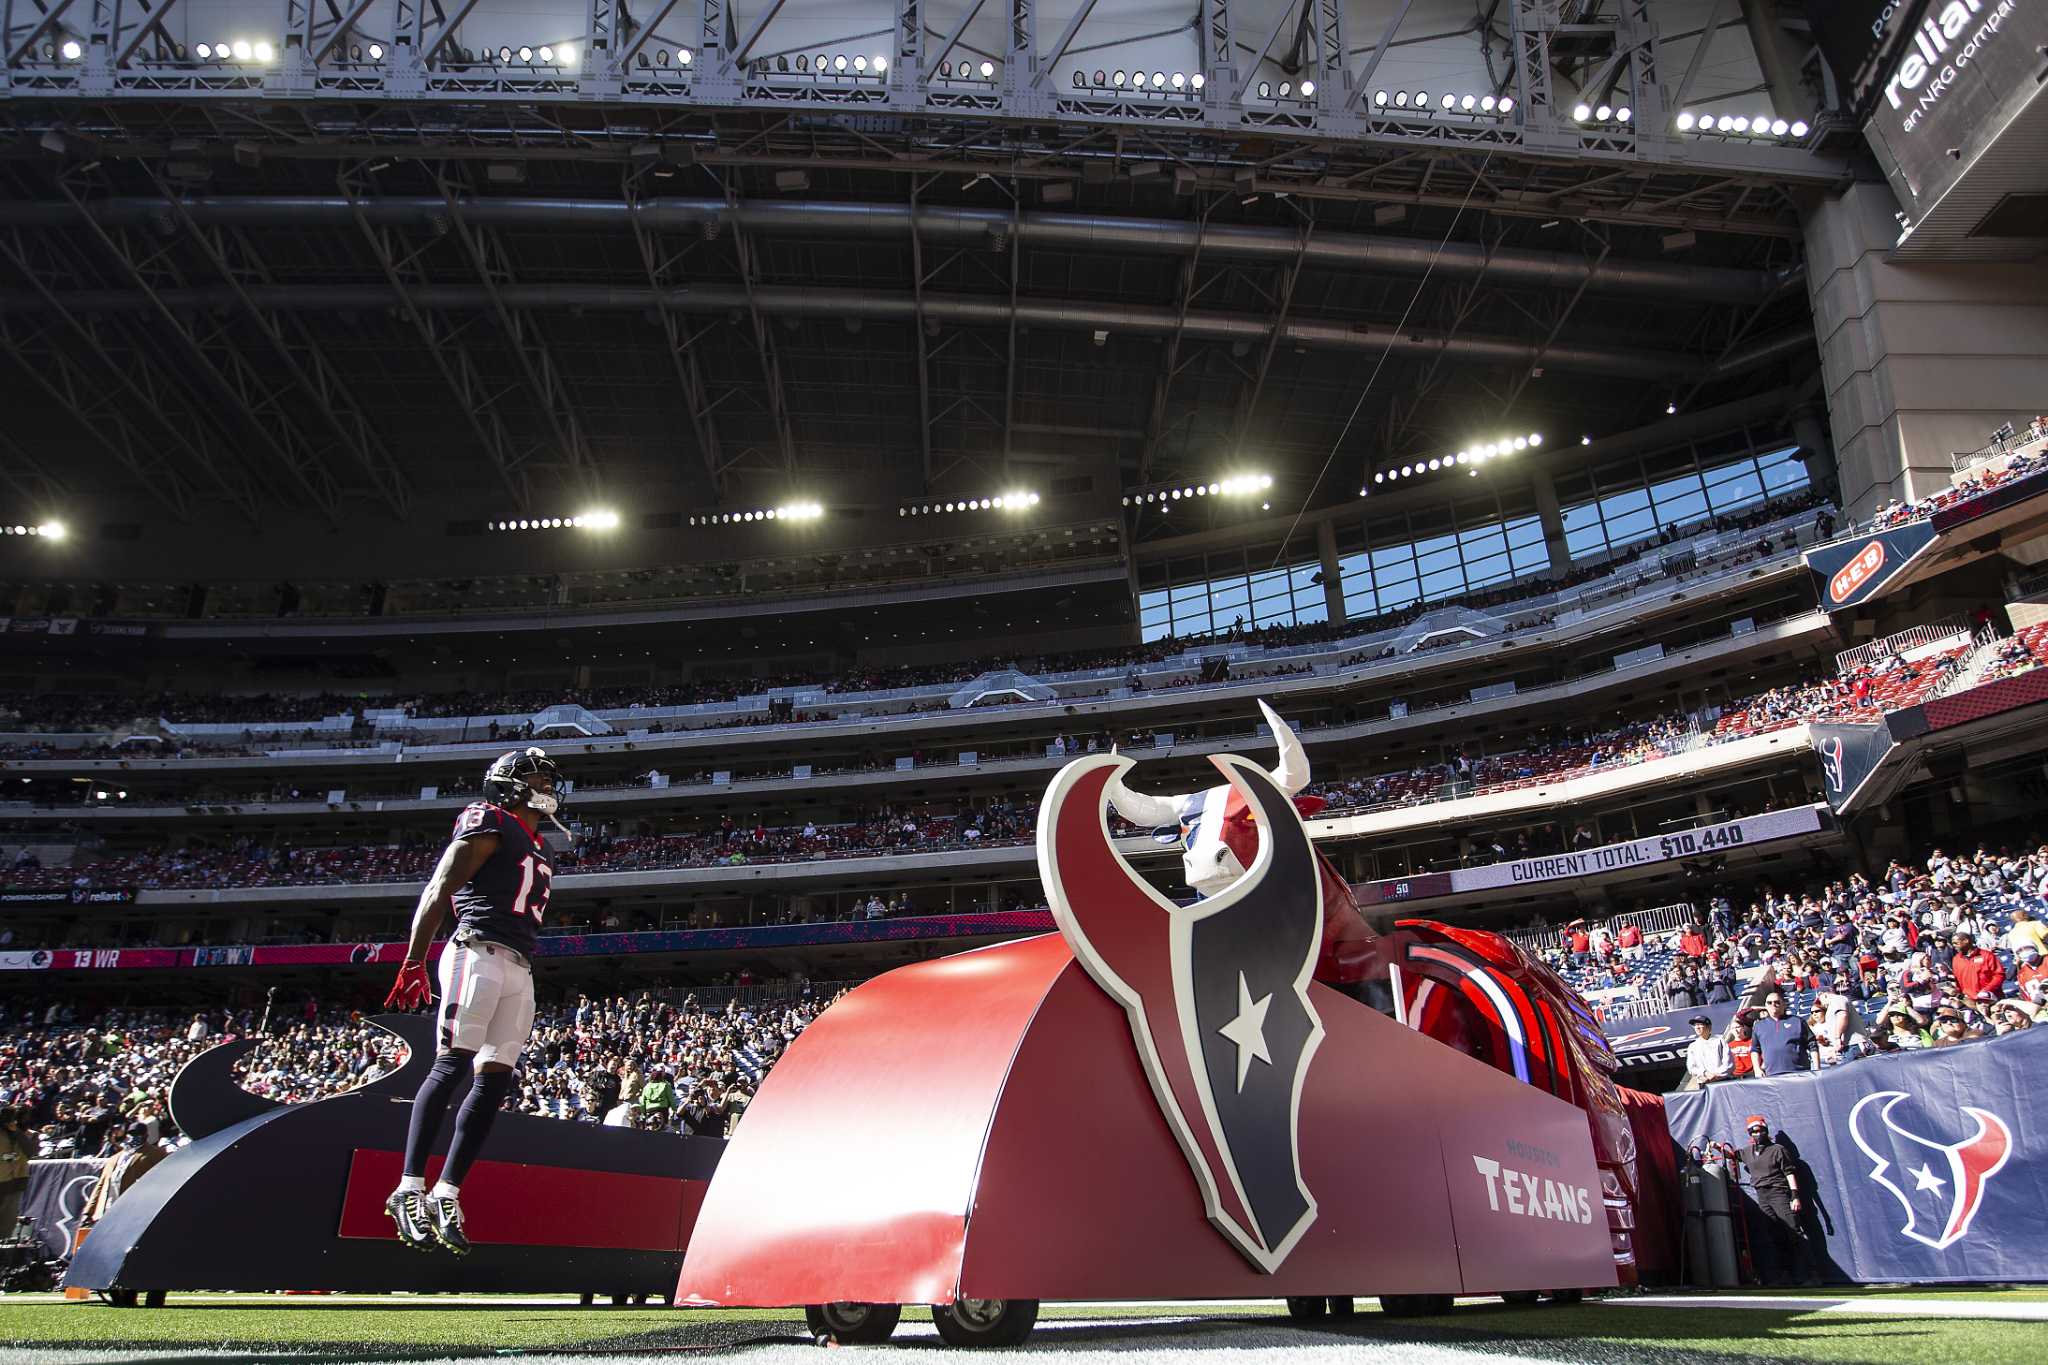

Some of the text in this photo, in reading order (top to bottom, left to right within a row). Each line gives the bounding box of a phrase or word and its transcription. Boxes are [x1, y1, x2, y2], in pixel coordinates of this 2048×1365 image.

[1903, 109, 1922, 133] an
[1919, 64, 1957, 110] NRG
[1511, 824, 1744, 881] CURRENT TOTAL: $10,440
[513, 855, 553, 924] 13
[74, 950, 119, 968] 13 WR
[1472, 1154, 1593, 1225] TEXANS
